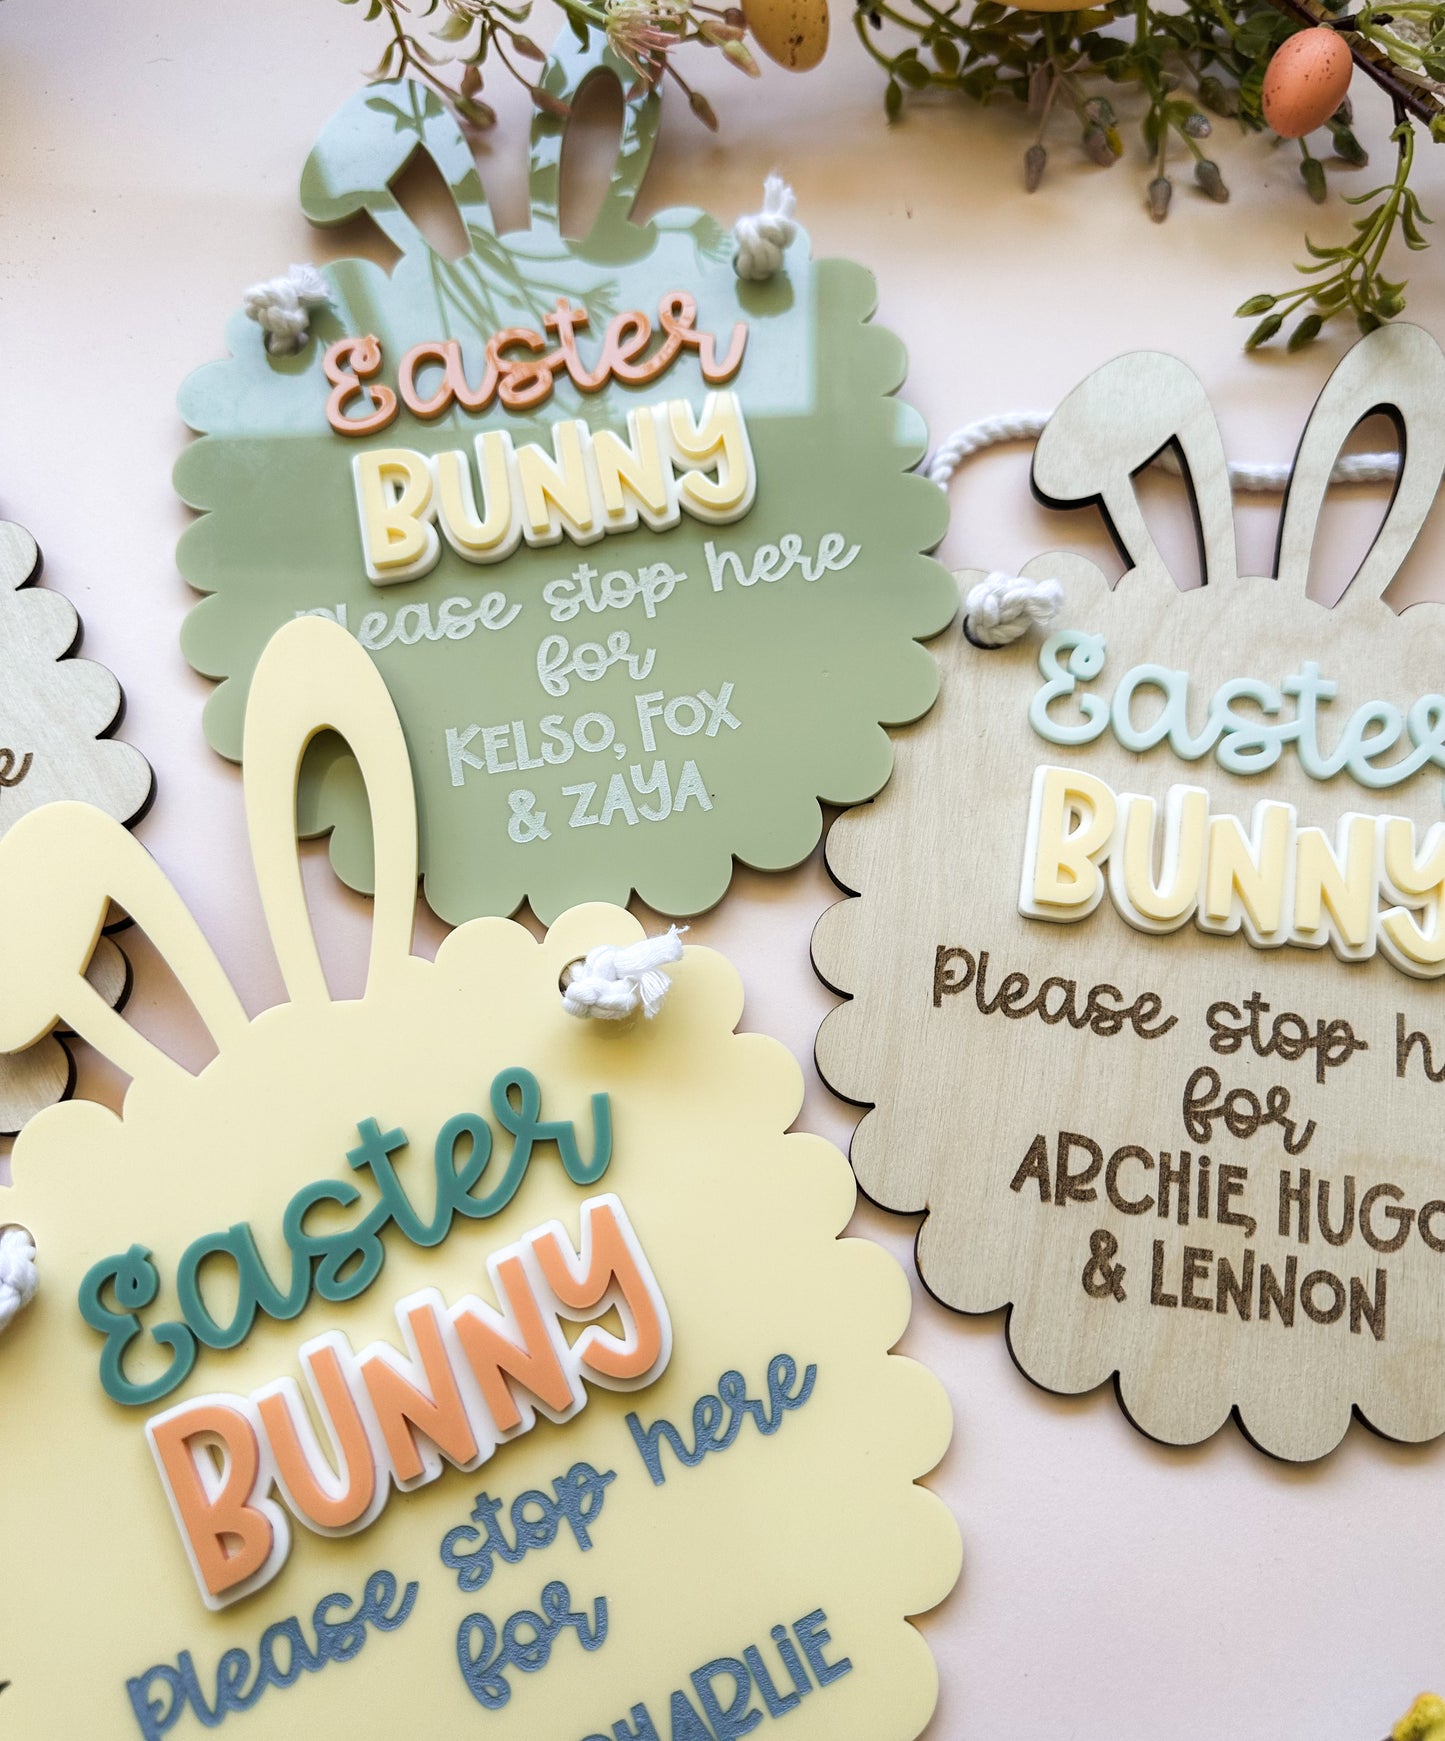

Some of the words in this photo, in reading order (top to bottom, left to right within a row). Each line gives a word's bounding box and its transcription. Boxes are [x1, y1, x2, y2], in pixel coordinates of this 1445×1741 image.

[322, 291, 748, 437] Easter
[352, 390, 757, 588] BUNNY
[295, 591, 523, 651] lease
[542, 563, 688, 622] stop
[704, 532, 861, 592] here
[537, 630, 657, 697] for
[445, 710, 627, 787] KELSO,
[634, 681, 742, 752] FOX
[507, 789, 552, 843] &
[561, 759, 713, 828] ZAYA
[1018, 766, 1445, 978] BUNNY
[1205, 991, 1368, 1084] stop
[1182, 1066, 1317, 1155] for
[78, 1066, 613, 1406] Easter
[1081, 1229, 1127, 1303] &
[1150, 1239, 1387, 1341] LENNON
[144, 1193, 674, 1611] BUNNY
[440, 1461, 617, 1594] stop
[625, 1353, 818, 1487] here
[456, 1580, 608, 1710] for
